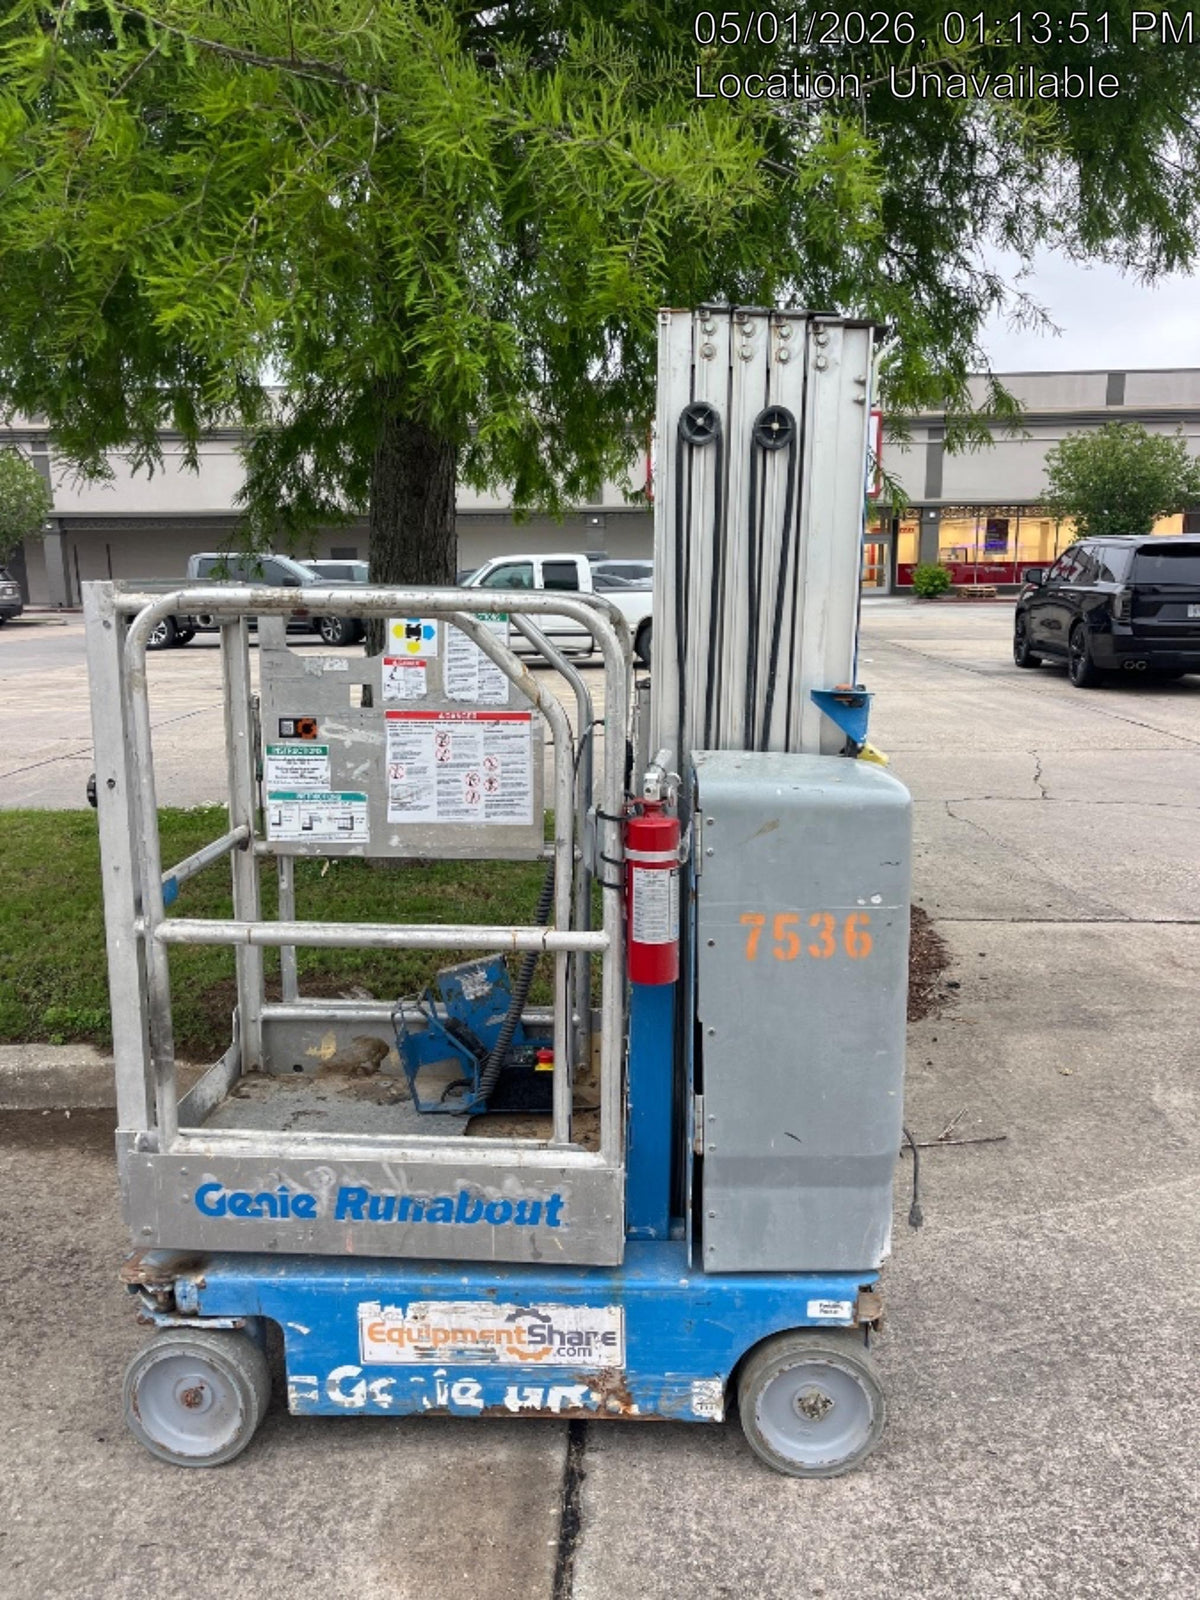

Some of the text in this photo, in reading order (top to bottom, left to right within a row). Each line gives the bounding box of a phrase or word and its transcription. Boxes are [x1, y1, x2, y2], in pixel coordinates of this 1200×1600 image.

[739, 911, 873, 961] 7536
[194, 1182, 565, 1228] Genie Runabout
